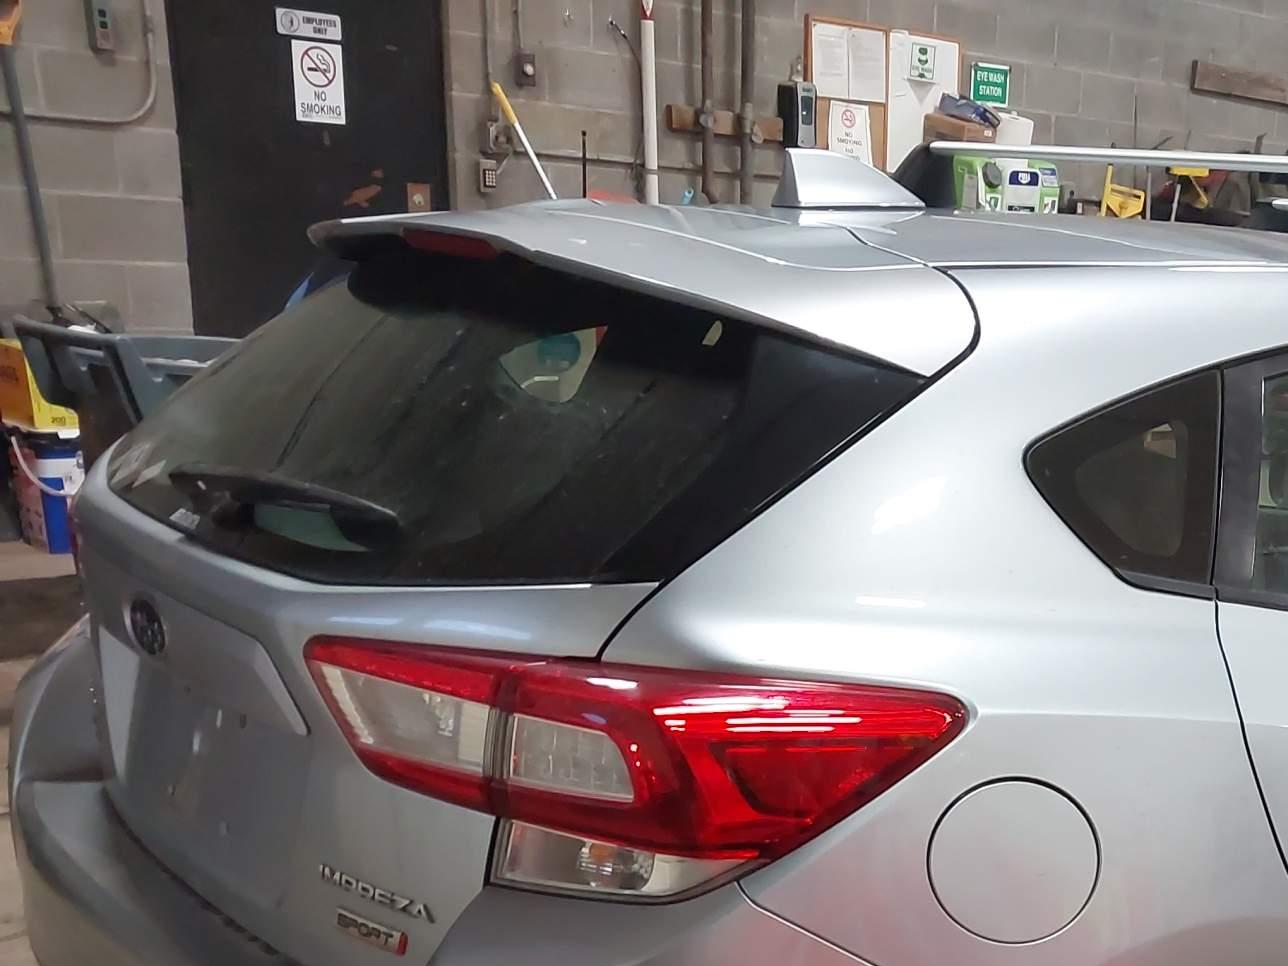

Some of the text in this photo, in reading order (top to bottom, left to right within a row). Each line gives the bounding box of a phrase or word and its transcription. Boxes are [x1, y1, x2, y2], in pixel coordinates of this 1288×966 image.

[302, 16, 336, 28] EMPLOYEES
[313, 26, 327, 36] ONLY
[976, 70, 1005, 84] EYE WASH
[313, 90, 328, 102] NO
[978, 84, 1003, 97] STATION
[300, 102, 341, 116] SMOKING
[319, 863, 435, 923] IMPREZA
[336, 912, 395, 946] SPORT
